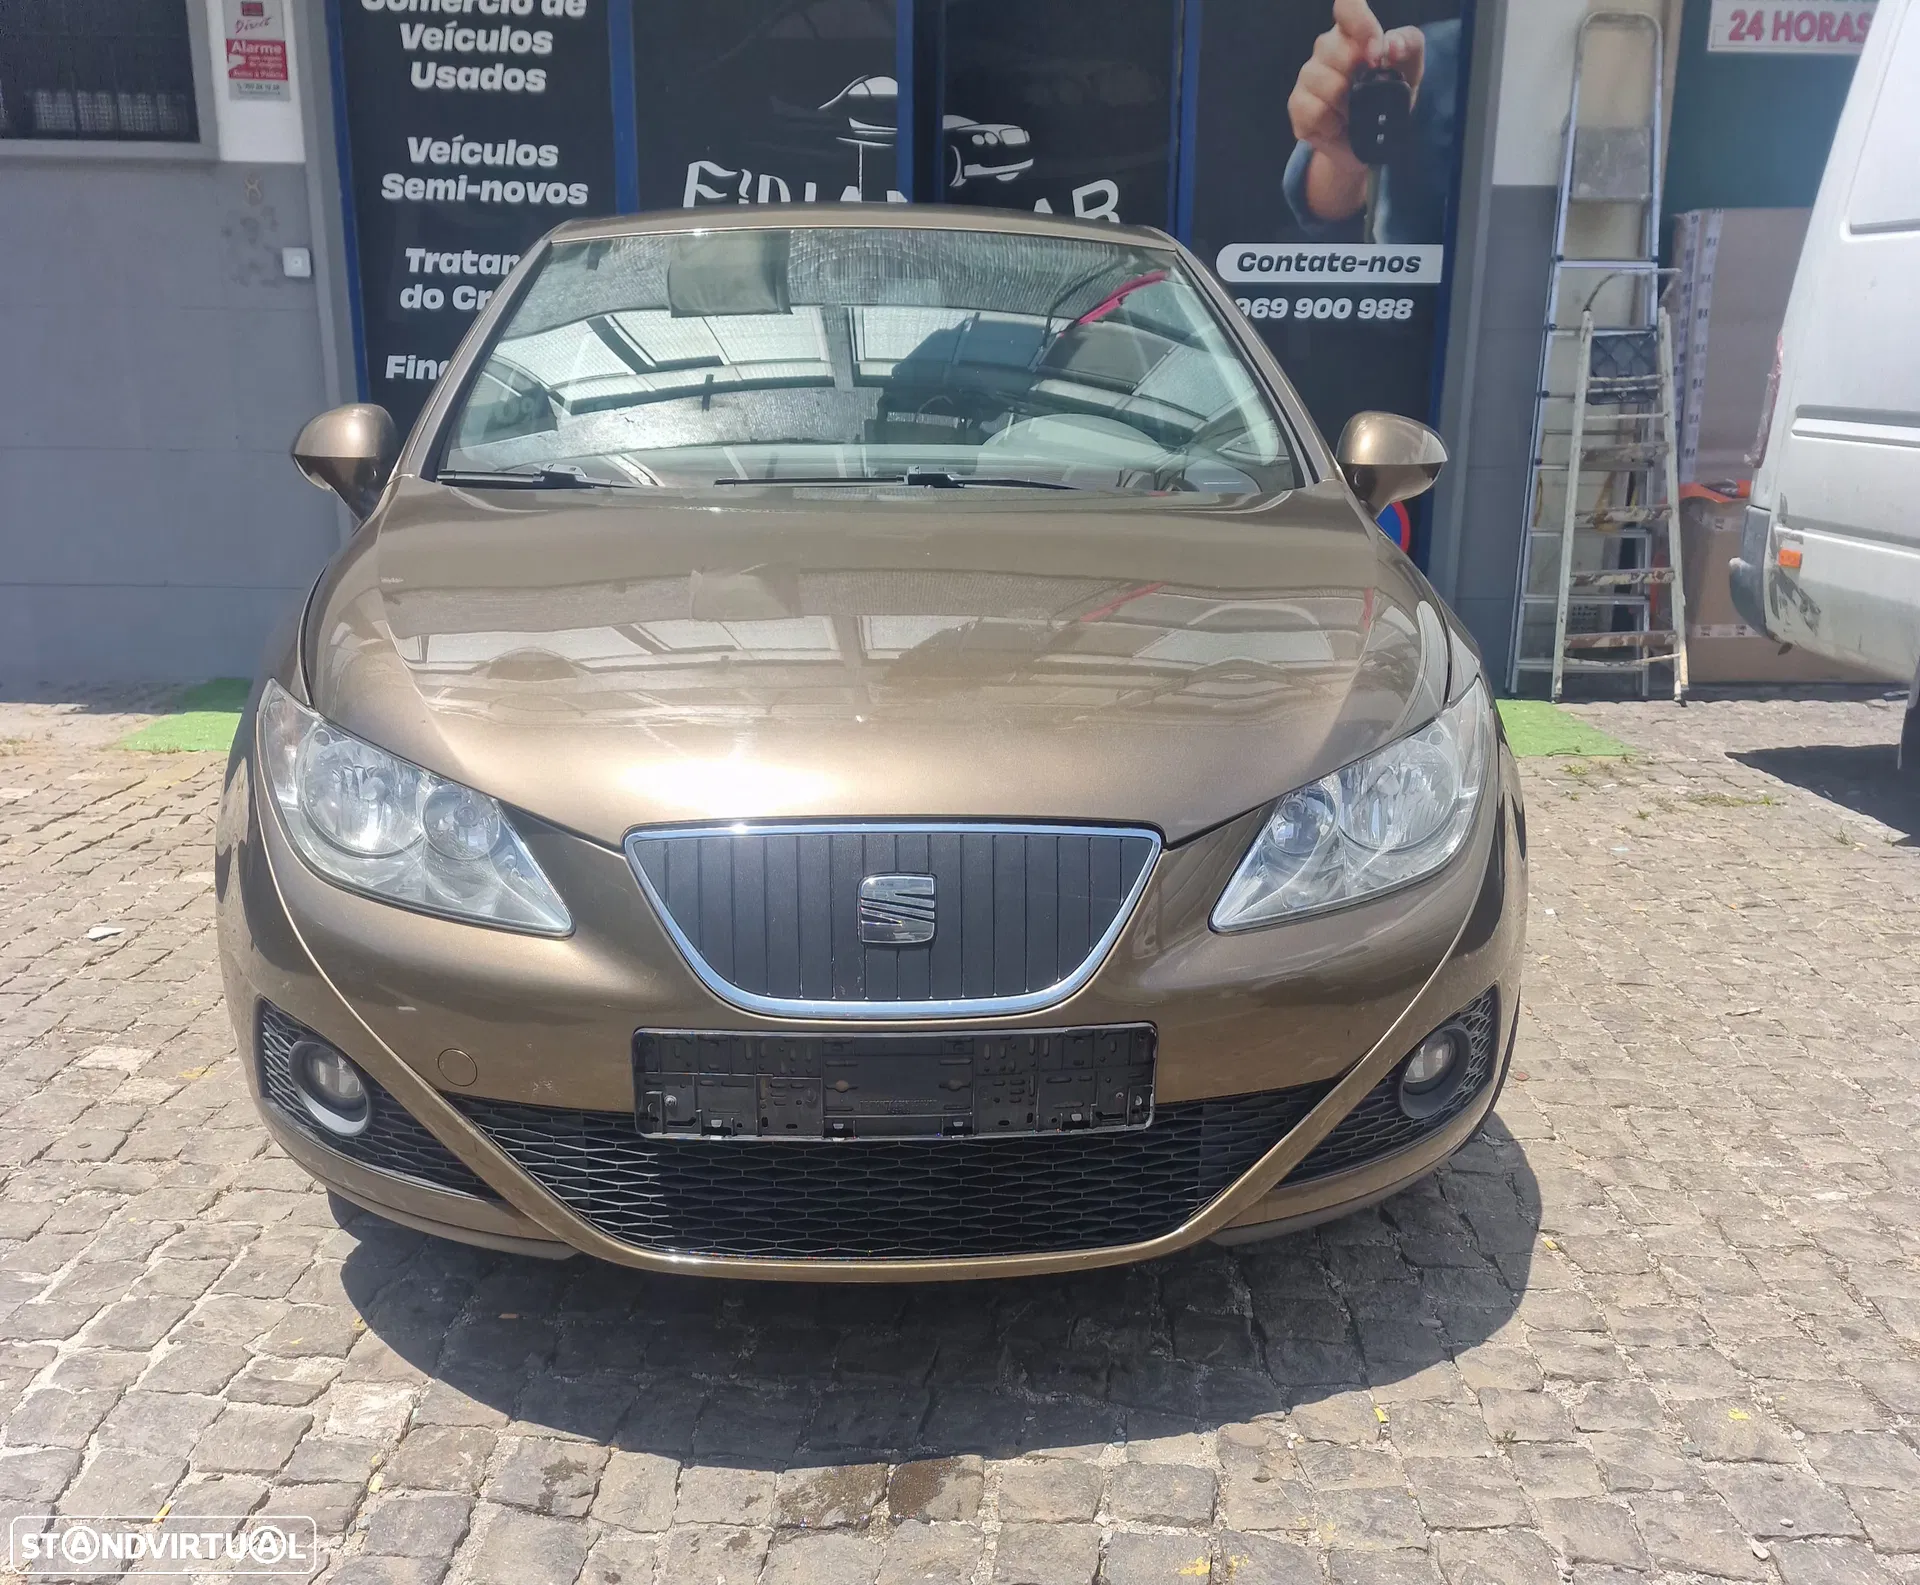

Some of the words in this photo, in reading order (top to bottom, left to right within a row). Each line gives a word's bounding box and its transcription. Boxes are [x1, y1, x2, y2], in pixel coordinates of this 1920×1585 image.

[400, 21, 553, 54] Veículos
[1729, 9, 1764, 41] 24
[1772, 10, 1874, 42] HORAS
[231, 40, 282, 54] Alarme
[410, 61, 547, 92] Usados
[407, 134, 558, 167] Veículos
[381, 173, 589, 205] Semi-novos
[1237, 252, 1421, 273] Contate-nos
[400, 284, 444, 309] do
[1294, 298, 1352, 319] 900
[1357, 298, 1414, 319] 988
